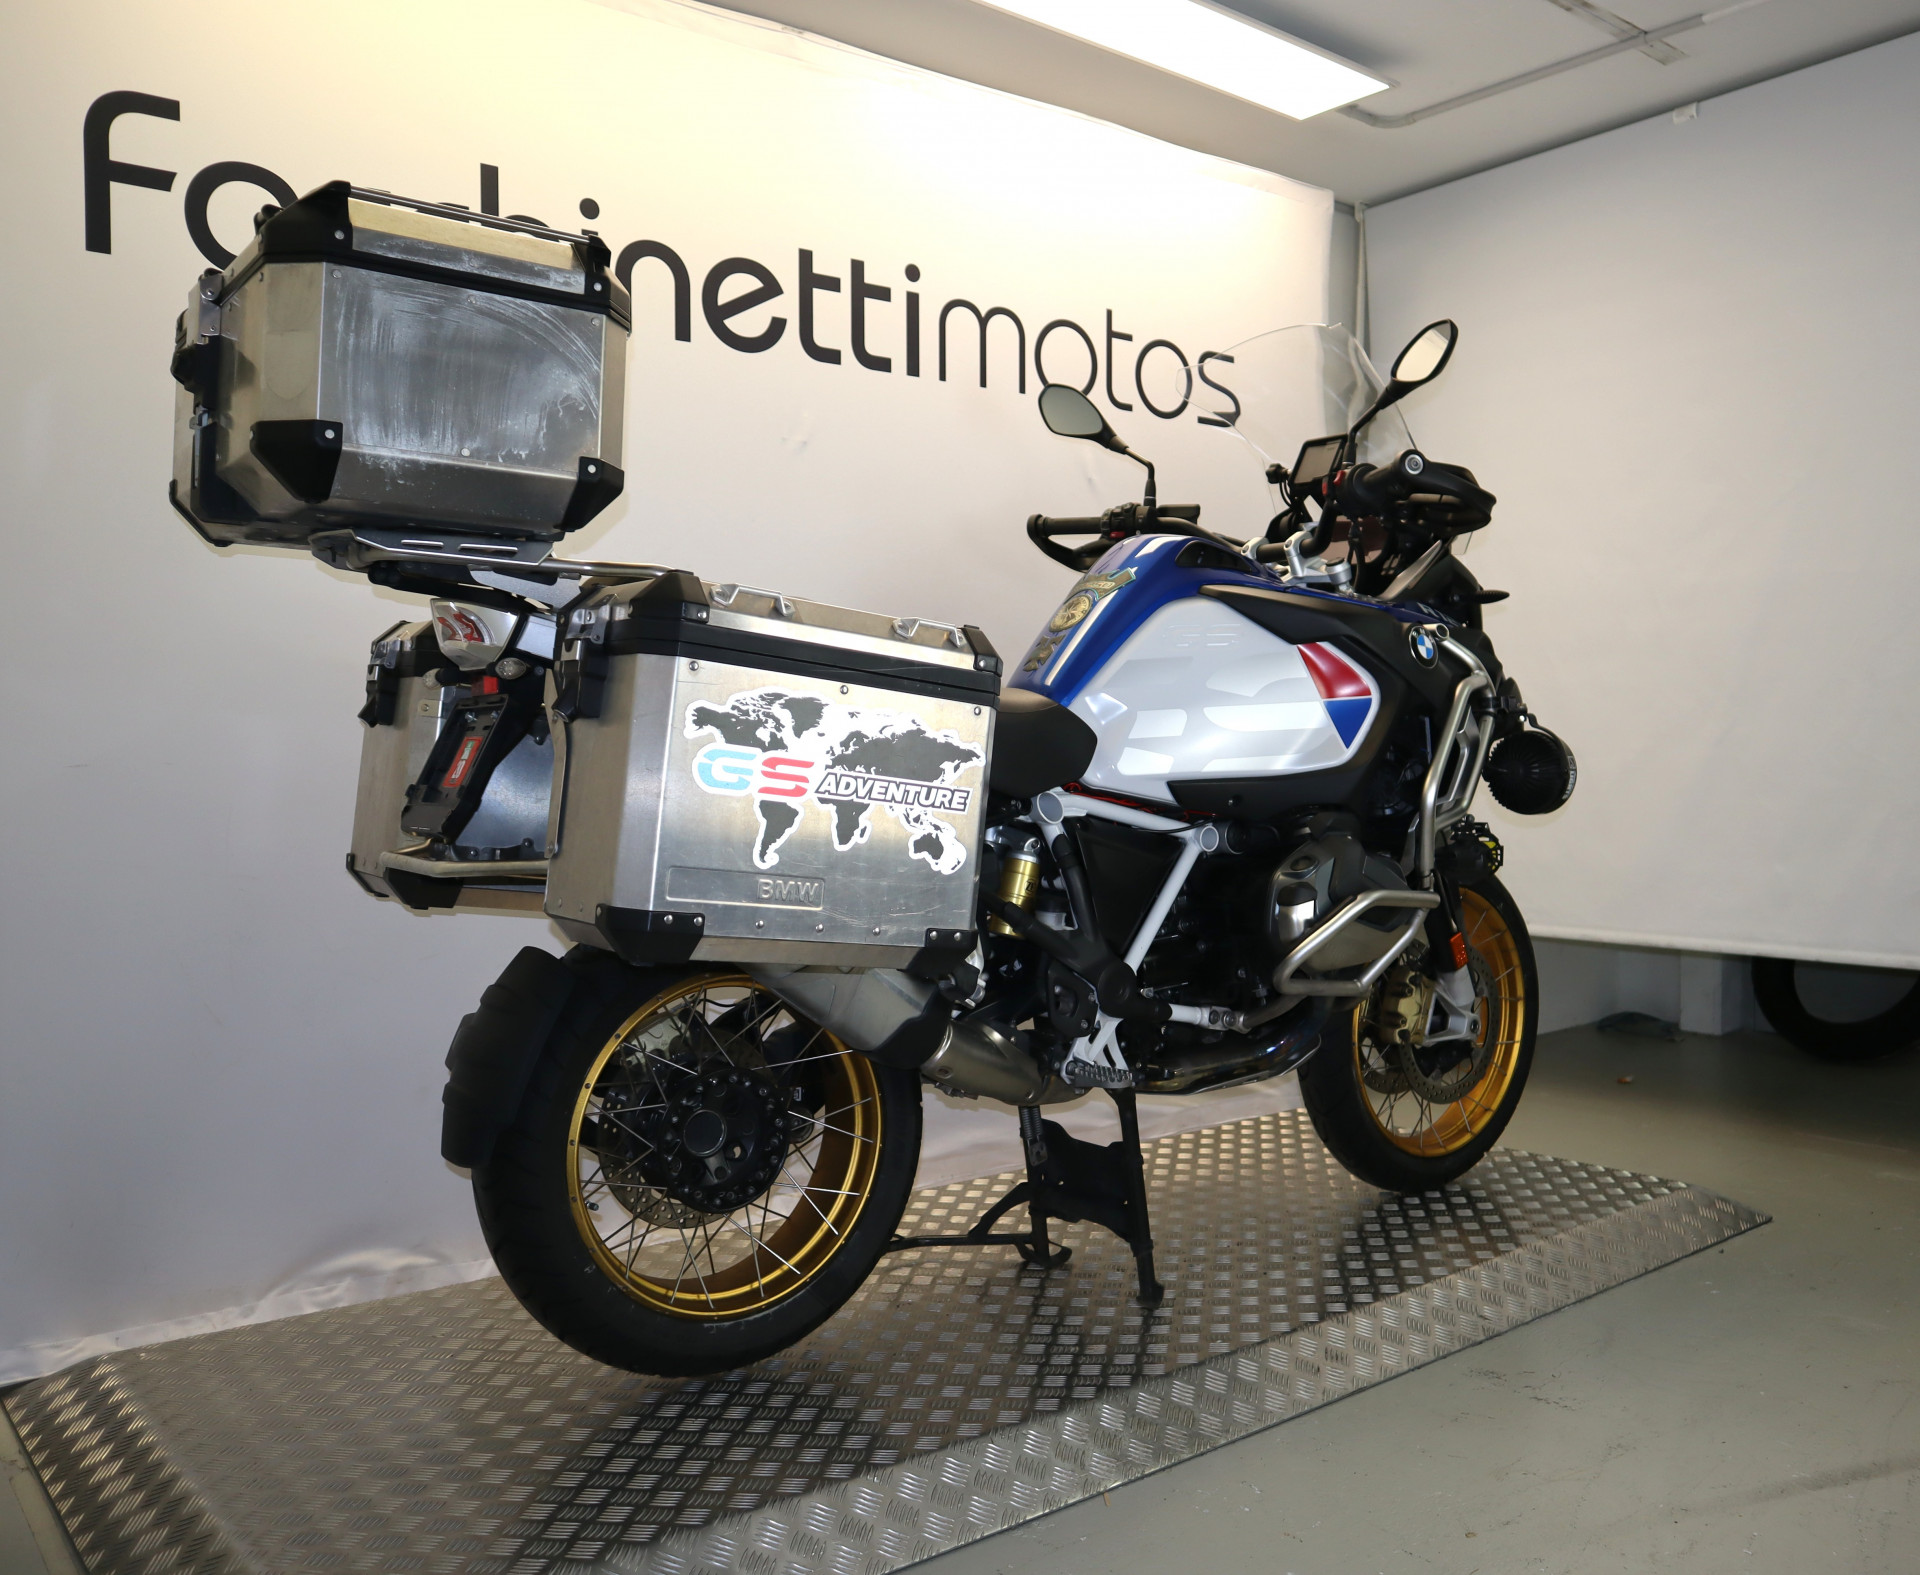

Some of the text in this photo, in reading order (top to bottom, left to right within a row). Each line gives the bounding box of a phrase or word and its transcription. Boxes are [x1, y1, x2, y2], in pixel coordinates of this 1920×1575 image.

[697, 747, 972, 812] GS ADVENTURE
[756, 877, 820, 903] BMW
